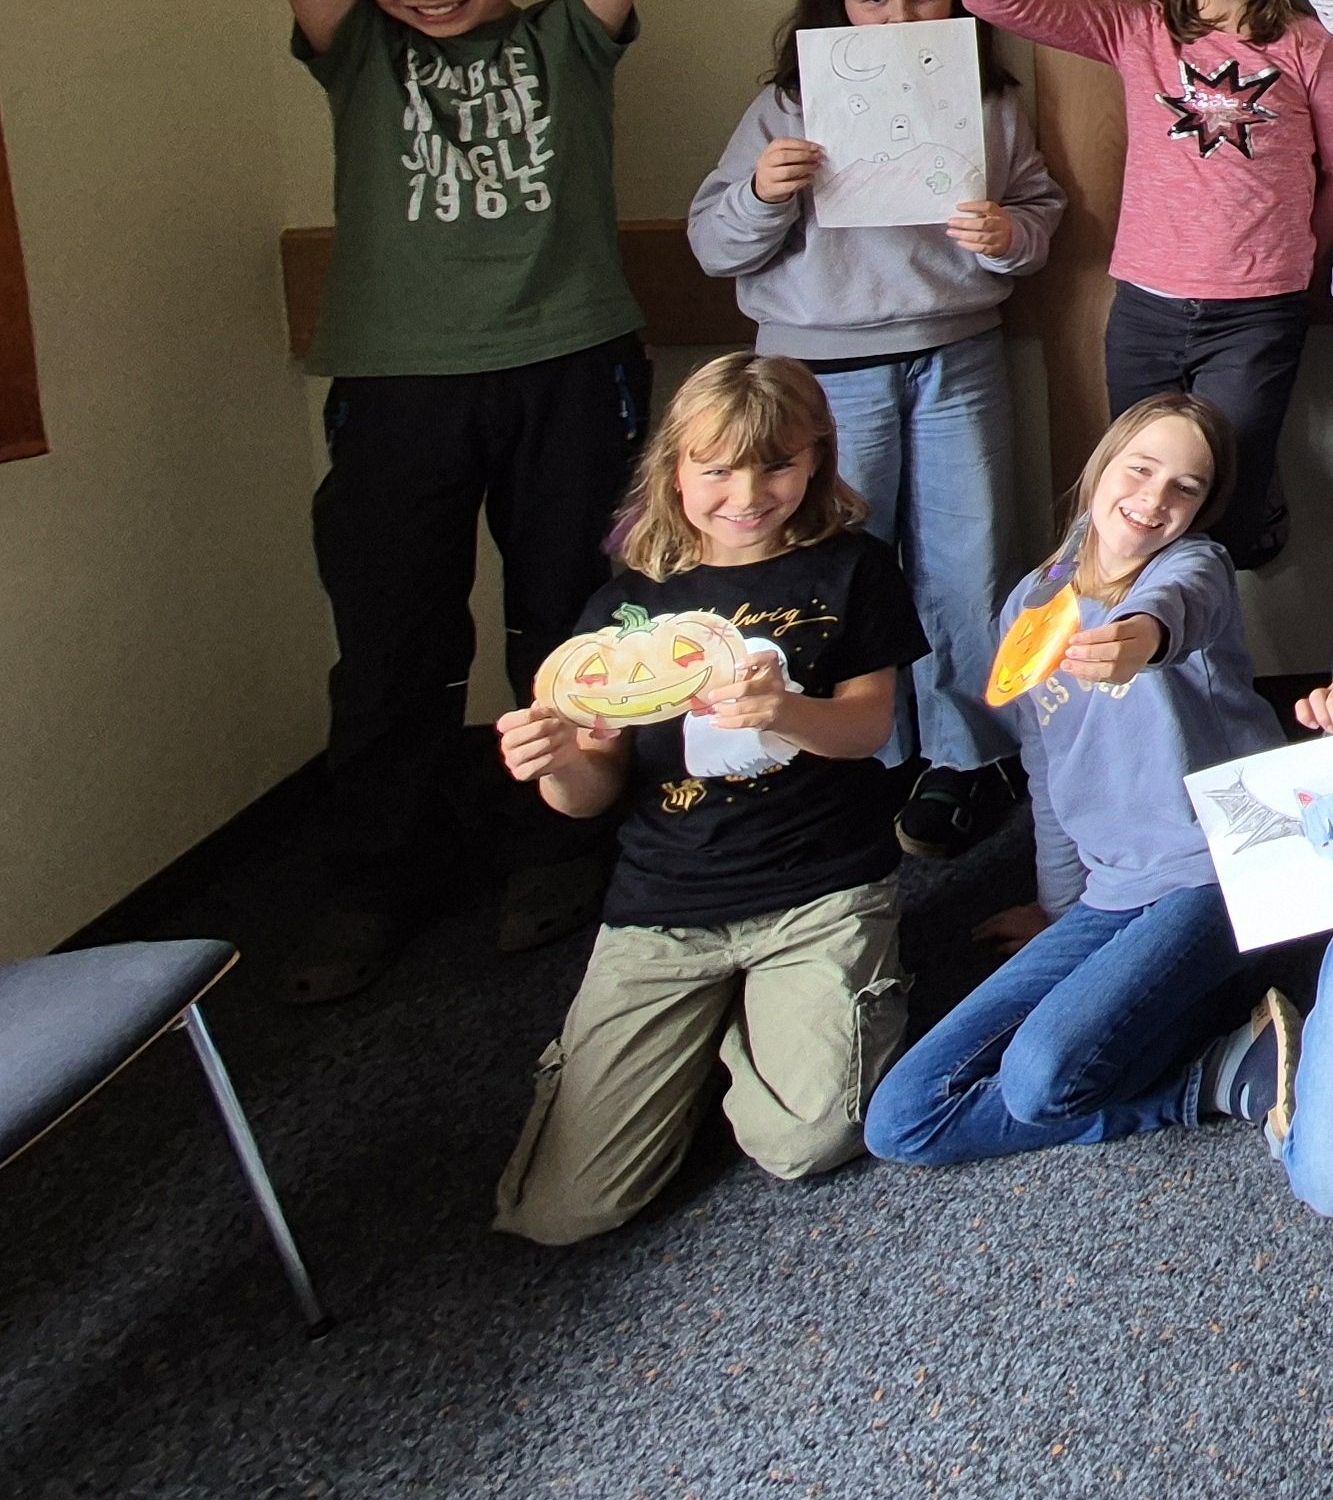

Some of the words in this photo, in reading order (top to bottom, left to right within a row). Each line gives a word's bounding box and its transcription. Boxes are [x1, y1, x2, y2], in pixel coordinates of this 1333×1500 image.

[451, 75, 542, 142] THE
[401, 115, 556, 181] JUNGLE
[407, 166, 552, 222] 1965
